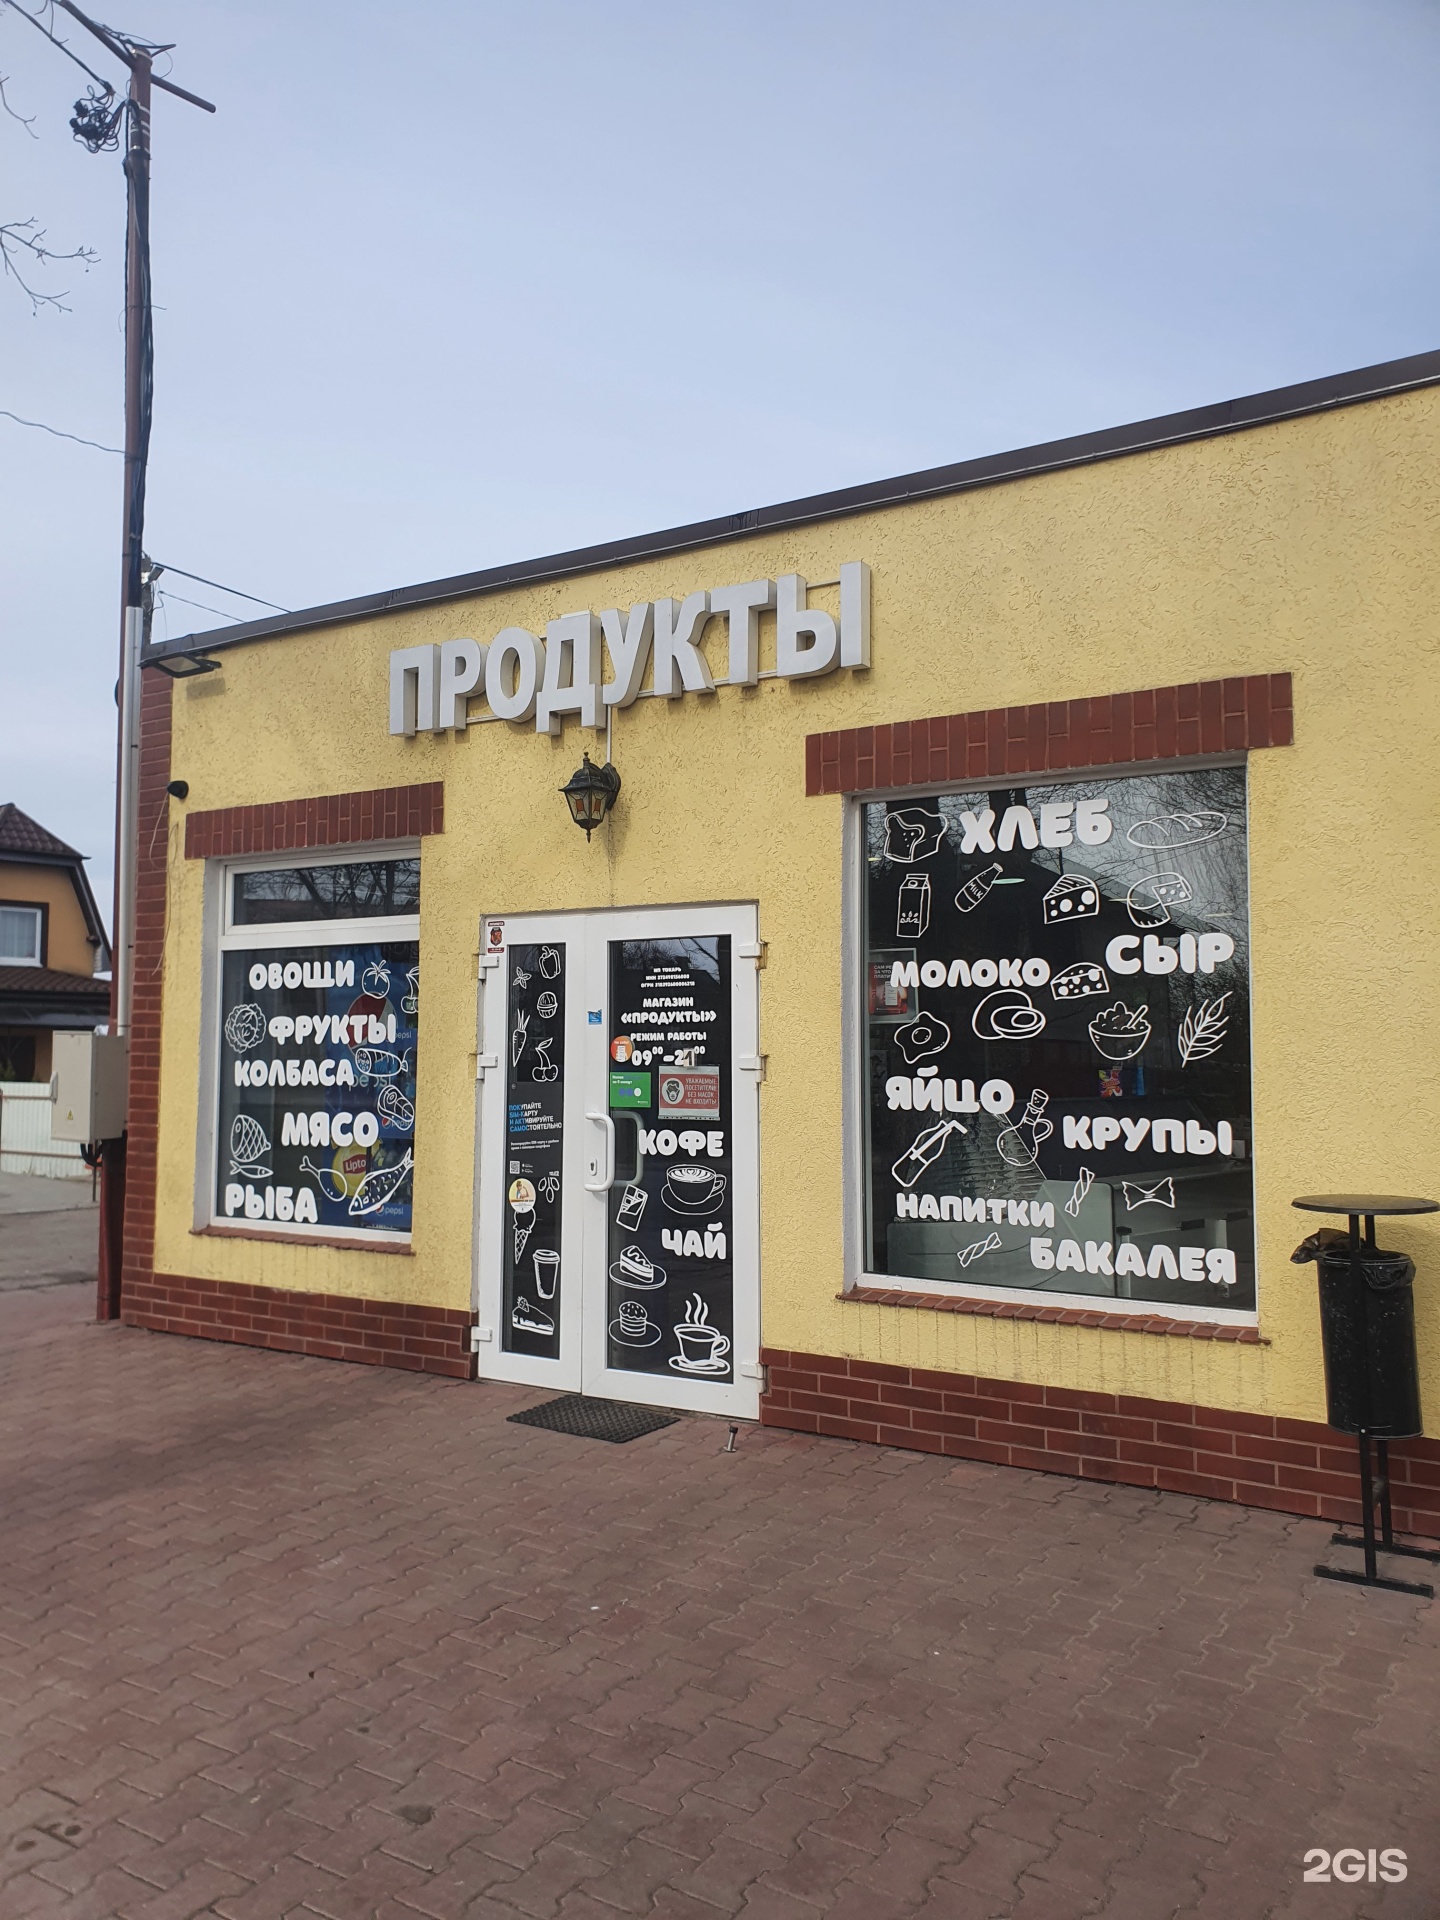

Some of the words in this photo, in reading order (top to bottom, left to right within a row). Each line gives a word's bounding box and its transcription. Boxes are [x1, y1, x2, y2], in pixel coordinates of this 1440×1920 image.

[390, 561, 870, 738] ПРОДУКТЫ
[959, 799, 1112, 854] ХЛЕБ
[968, 882, 984, 899] MILK
[1104, 931, 1235, 975] СЫР
[249, 960, 355, 991] ОВОЩИ
[890, 957, 1050, 988] МОЛОКО
[620, 1010, 717, 1025] «ПРОДУКТЫ»
[642, 997, 694, 1008] МАГАЗИН
[268, 1014, 397, 1045] ФРУКТЫ
[630, 1032, 665, 1042] РЕЖИМ
[667, 1031, 707, 1041] РАБОТЫ
[234, 1058, 355, 1088] КОЛБАСА
[885, 1066, 1015, 1114] ЯЙЦО
[281, 1110, 380, 1148] МЯСО
[509, 1122, 562, 1132] САМОСТОЯТЕЛЬНО
[638, 1129, 724, 1157] КОФЕ
[1062, 1115, 1233, 1156] КРУПЫ
[224, 1182, 319, 1224] РЫБА
[896, 1193, 1055, 1229] НАПИТКИ
[661, 1221, 727, 1260] ЧАЙ
[1030, 1237, 1237, 1284] БАКАЛЕЯ
